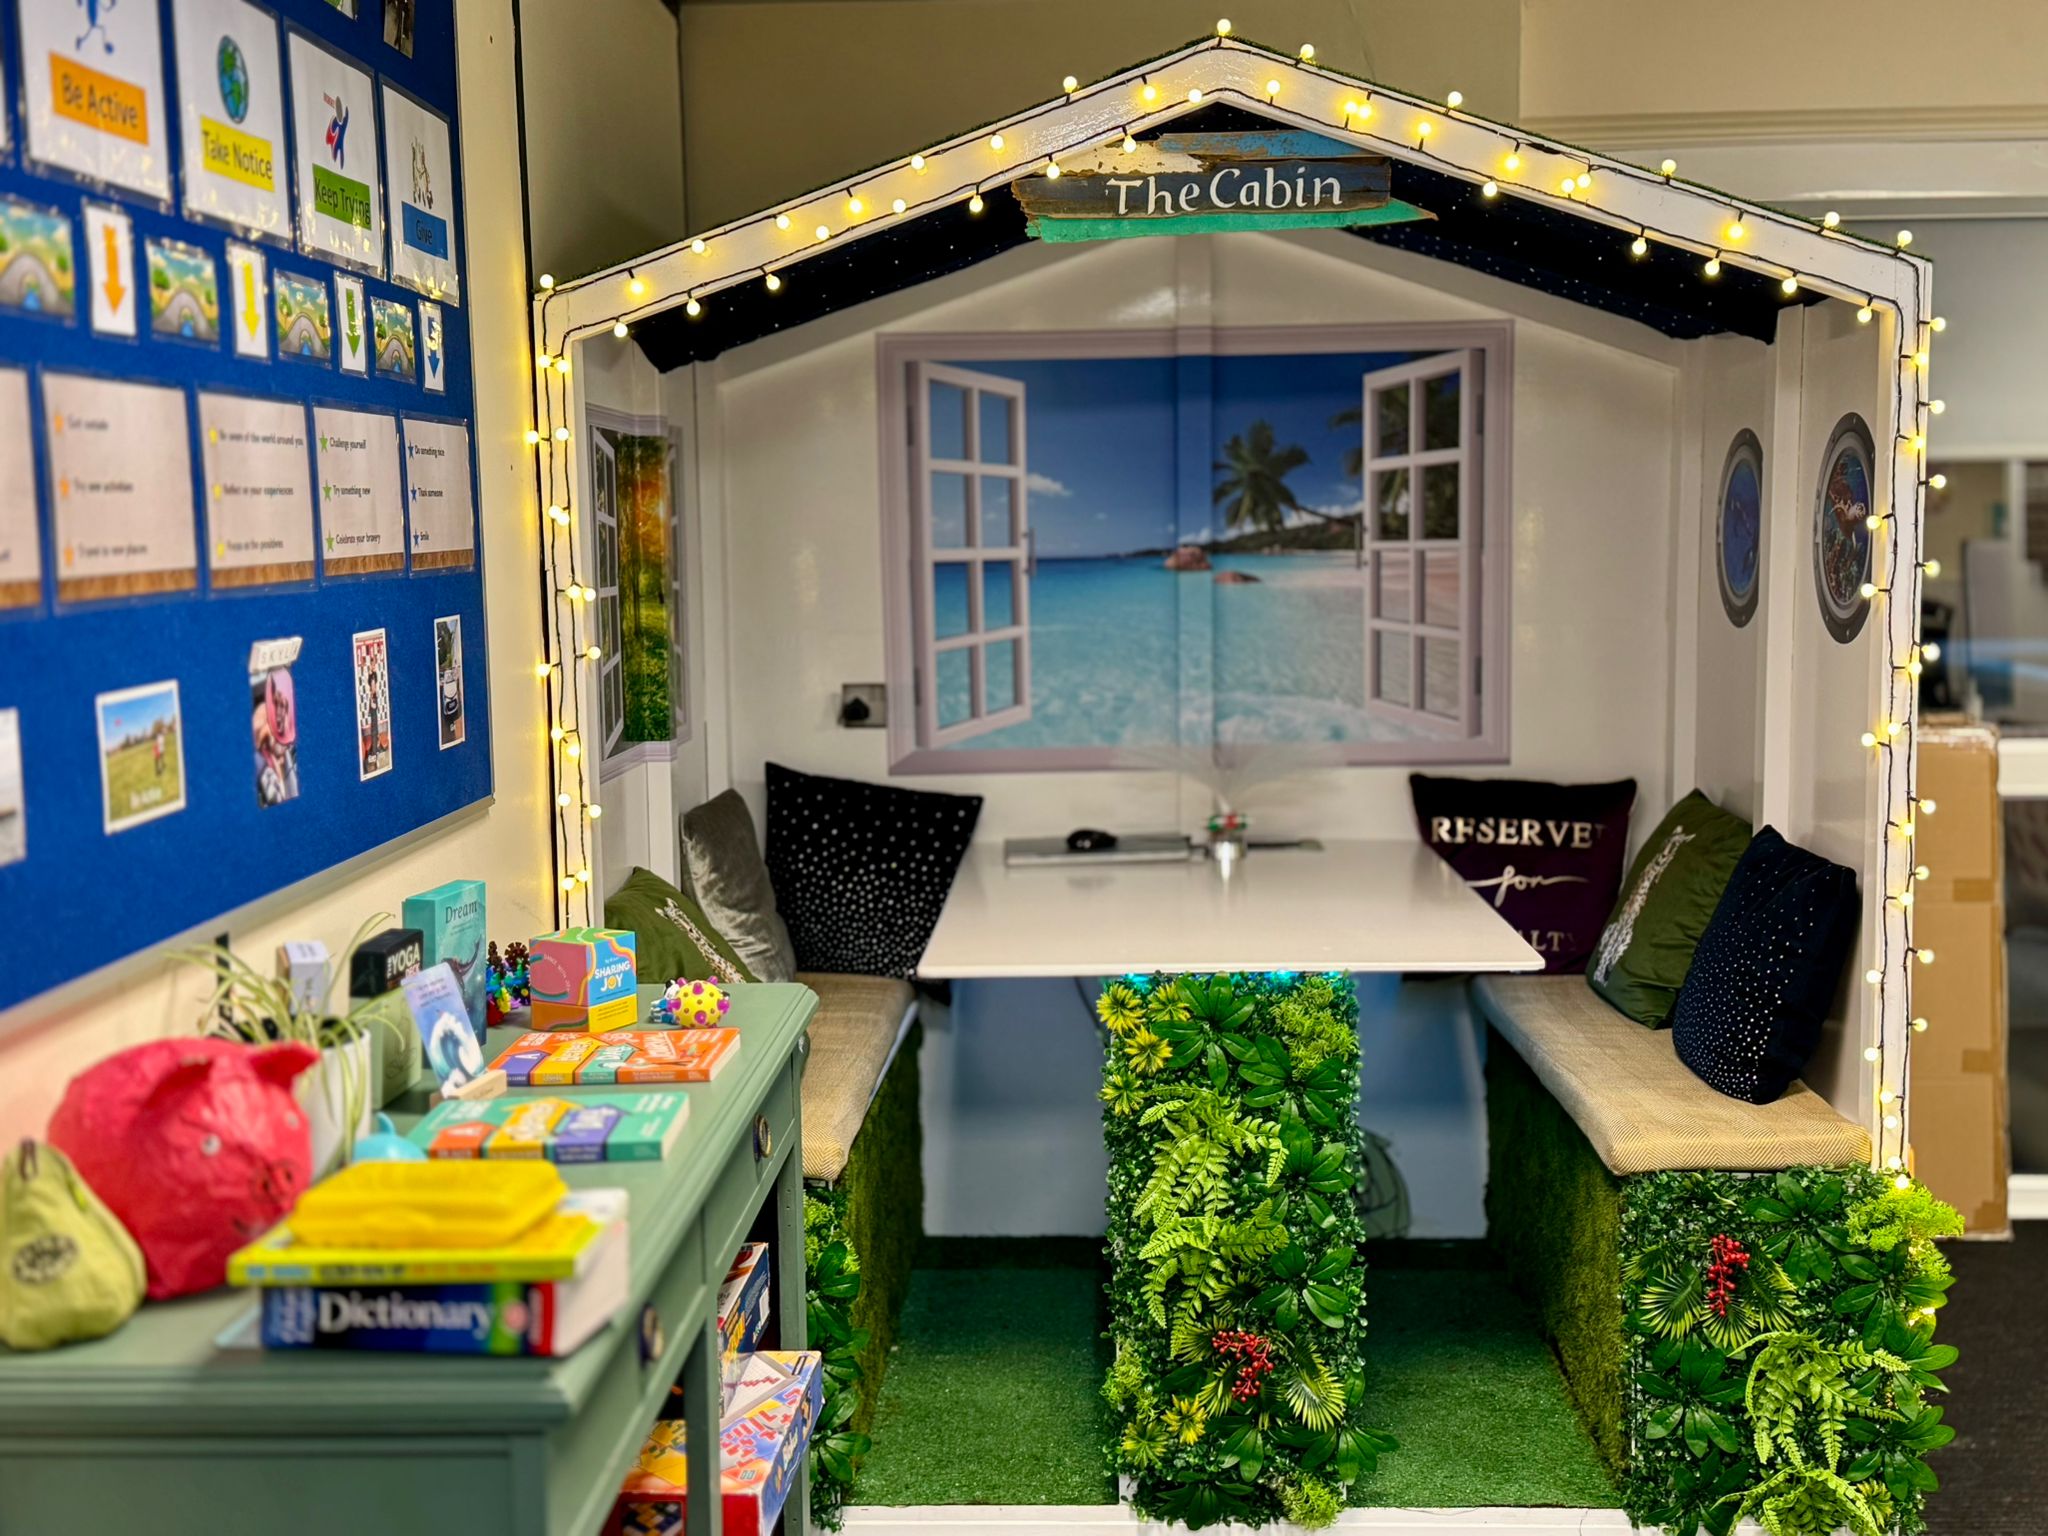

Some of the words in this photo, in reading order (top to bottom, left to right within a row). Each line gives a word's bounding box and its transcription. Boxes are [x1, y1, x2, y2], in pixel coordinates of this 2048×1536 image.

[62, 72, 82, 111] Be
[87, 84, 138, 130] Active
[202, 129, 231, 166] Take
[232, 141, 273, 180] Notice
[314, 177, 339, 213] Keep
[339, 187, 371, 226] Trying
[1104, 175, 1201, 216] The
[1208, 165, 1344, 212] Cabin
[415, 219, 433, 246] Give
[329, 437, 349, 451] Challenge
[350, 439, 367, 452] yourself
[341, 485, 362, 498] something
[366, 531, 381, 545] bravery
[1431, 816, 1607, 849] RESERVE
[445, 900, 478, 925] Dream
[392, 942, 421, 976] YOGA
[594, 960, 630, 980] SHARING
[600, 972, 624, 992] JOY
[318, 1289, 492, 1341] Dictionary
